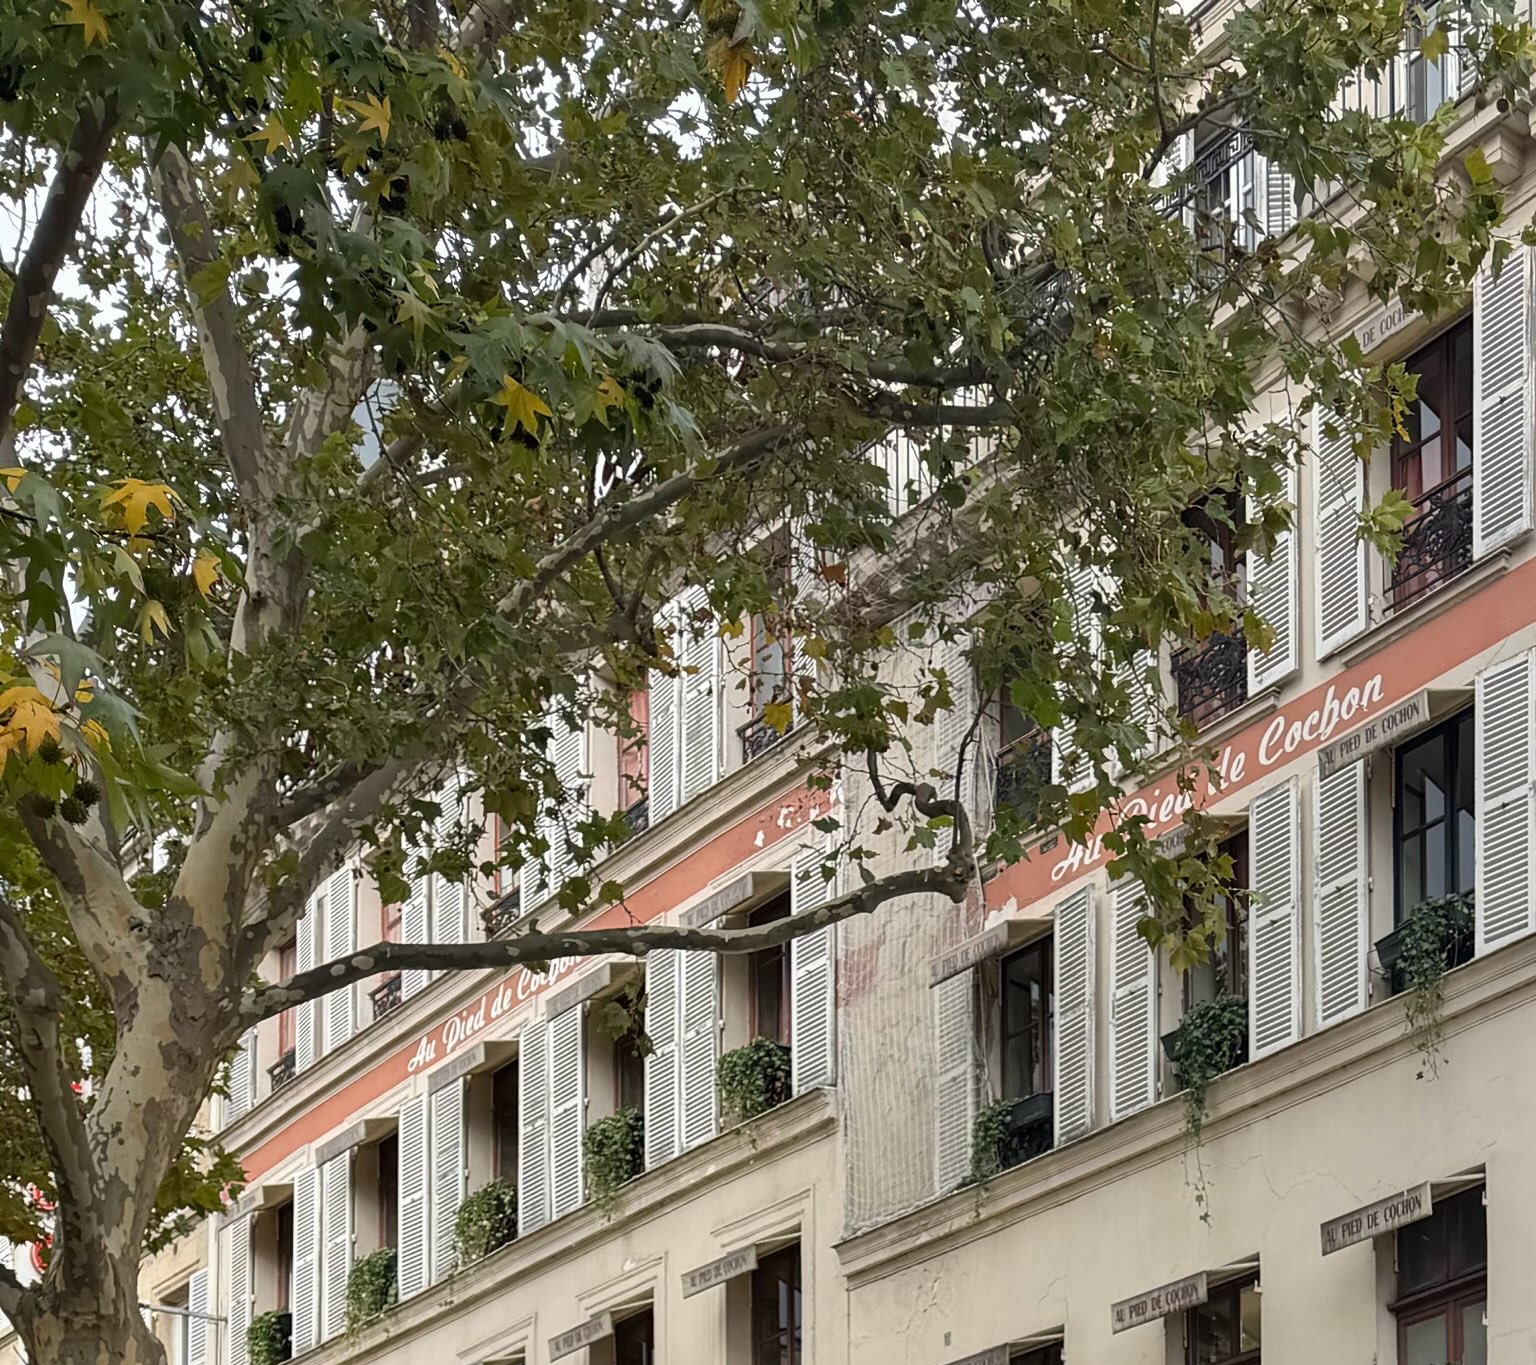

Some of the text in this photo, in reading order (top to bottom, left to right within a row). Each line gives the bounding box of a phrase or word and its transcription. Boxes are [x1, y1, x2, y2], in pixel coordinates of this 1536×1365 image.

[1258, 673, 1385, 765] Cochon
[1340, 735, 1361, 759] PIED
[1365, 726, 1378, 745] DE
[1381, 701, 1420, 734] COCHON
[407, 1036, 437, 1072] Au
[442, 996, 486, 1054] Pied
[490, 984, 512, 1019] de
[1341, 1217, 1362, 1239] PIED
[1366, 1210, 1380, 1230] DE
[1383, 1193, 1422, 1223] COCHON
[1128, 1301, 1148, 1320] PIED
[1151, 1294, 1163, 1312] DE
